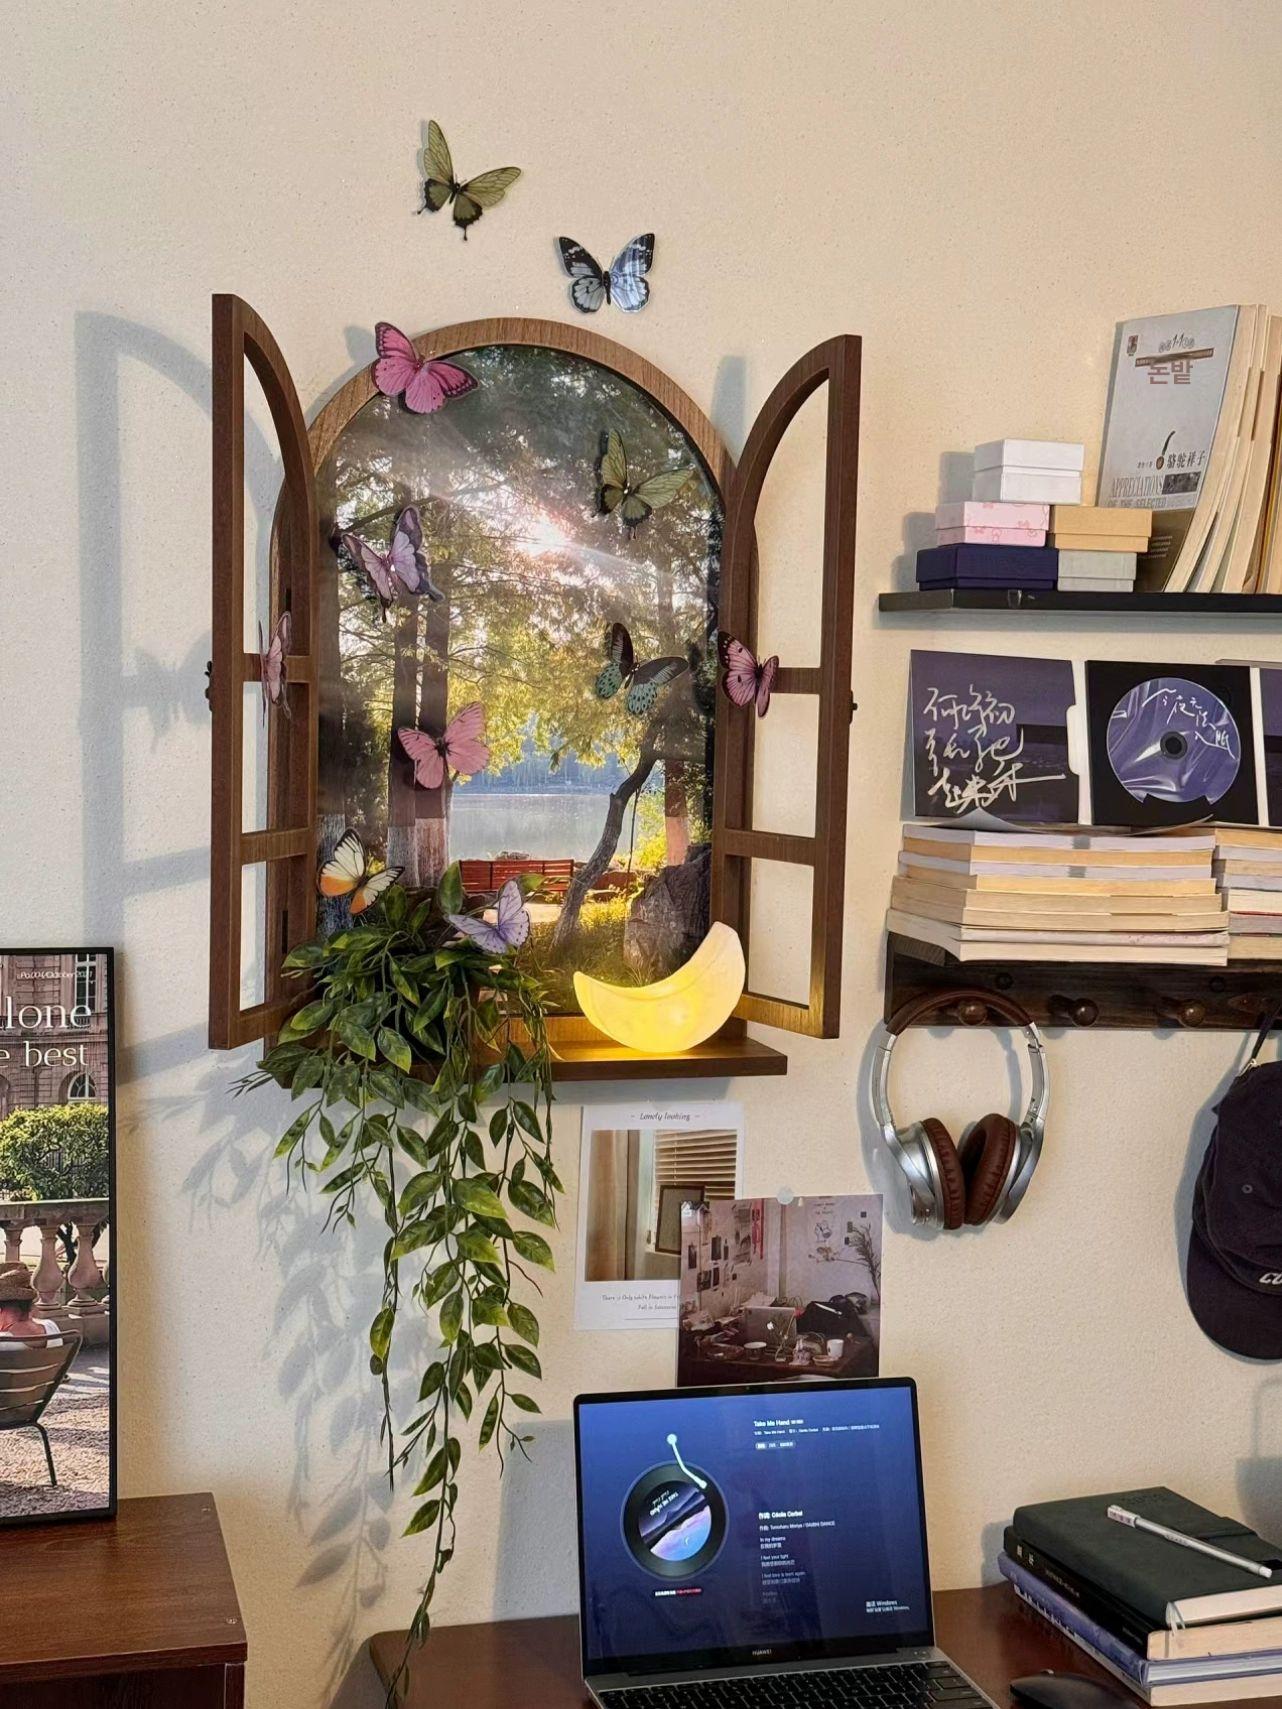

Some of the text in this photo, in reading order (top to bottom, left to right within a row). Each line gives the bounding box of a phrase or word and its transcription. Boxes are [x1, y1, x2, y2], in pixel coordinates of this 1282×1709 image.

[24, 1041, 88, 1067] best
[640, 1111, 690, 1121] Lonely looking
